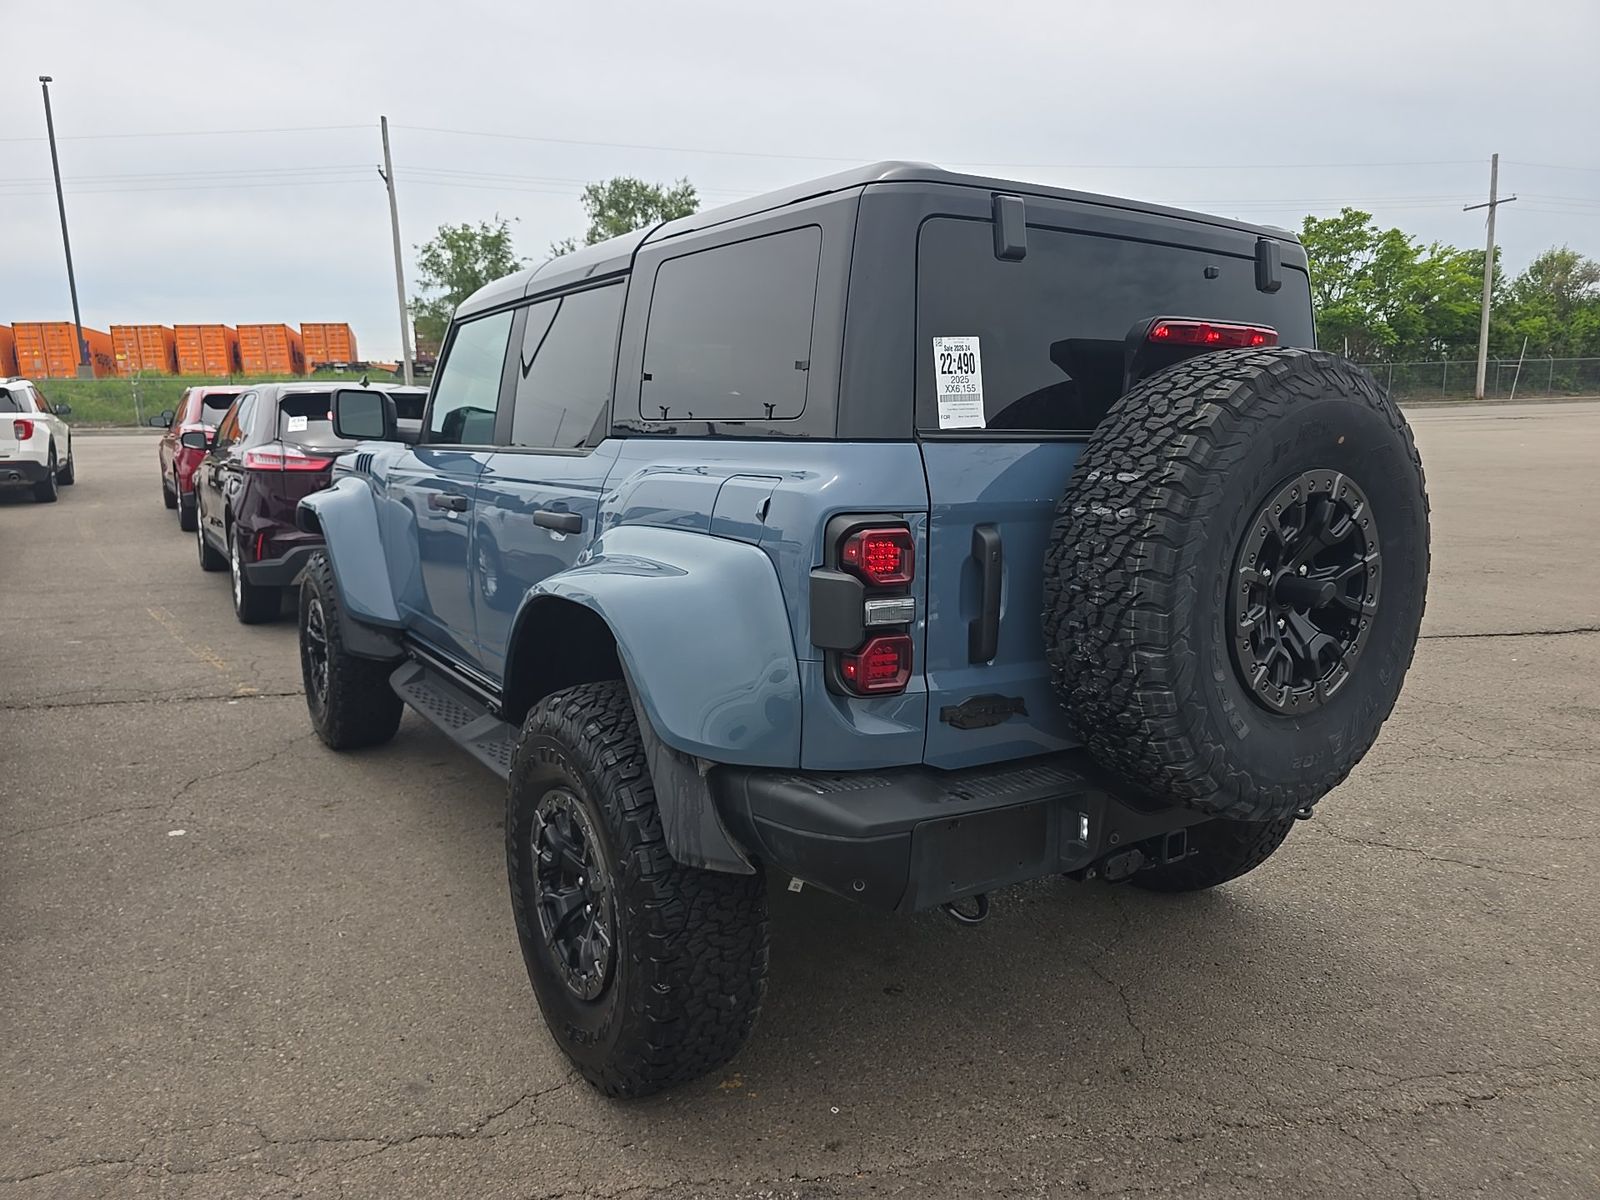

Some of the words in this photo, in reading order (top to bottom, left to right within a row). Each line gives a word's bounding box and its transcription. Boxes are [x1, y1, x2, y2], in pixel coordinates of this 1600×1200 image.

[940, 352, 976, 375] 22:490
[950, 376, 970, 384] 2025
[945, 384, 976, 394] XX6,155
